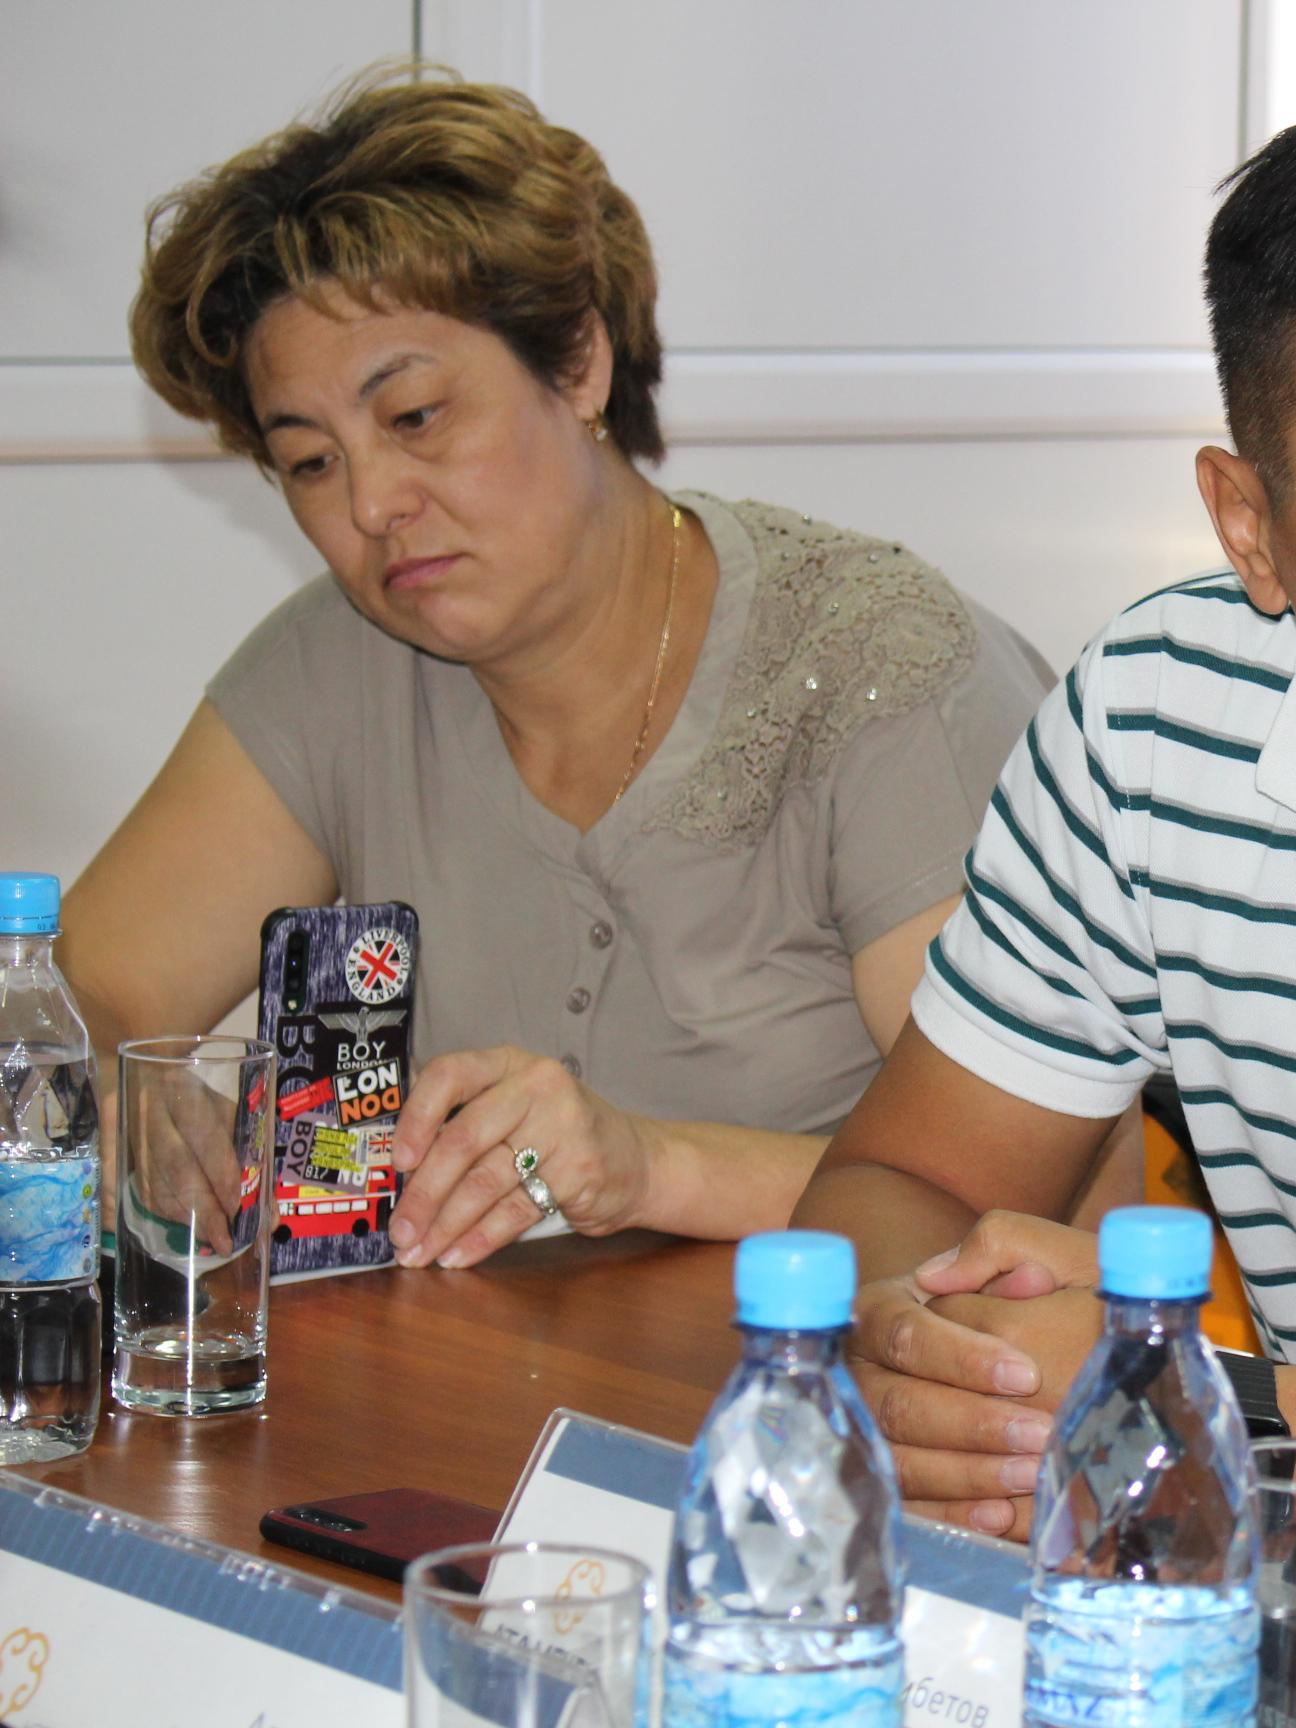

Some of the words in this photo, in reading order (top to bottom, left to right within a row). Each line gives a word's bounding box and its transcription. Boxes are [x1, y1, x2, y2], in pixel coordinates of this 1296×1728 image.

[361, 928, 410, 974] LIVERPOOL
[348, 959, 396, 1001] ENGLAND
[338, 1041, 386, 1062] BOY
[287, 1120, 312, 1178] BOY
